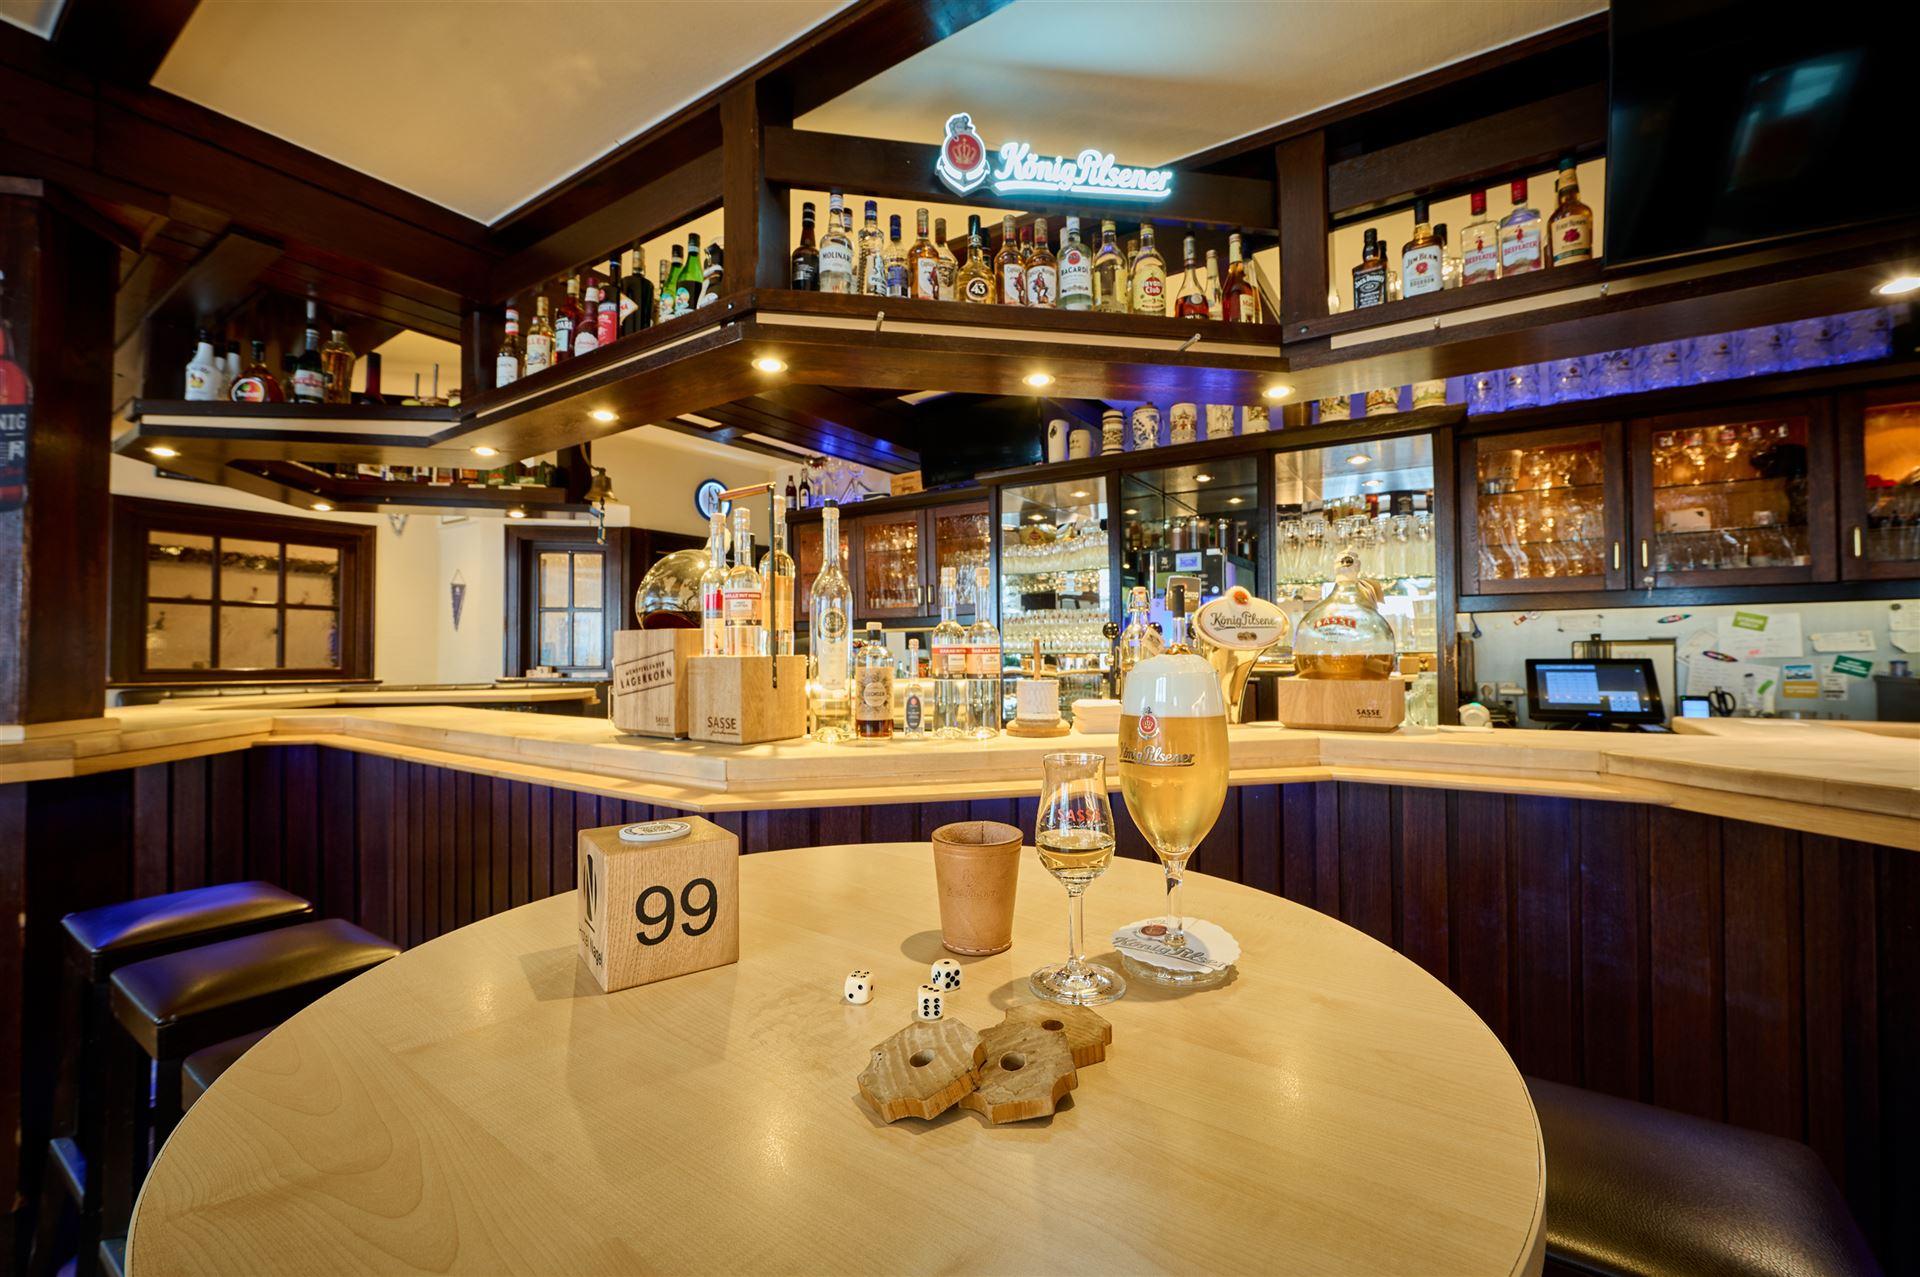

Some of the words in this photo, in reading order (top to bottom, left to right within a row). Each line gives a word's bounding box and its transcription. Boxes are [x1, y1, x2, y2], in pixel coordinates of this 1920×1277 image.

[970, 283, 986, 294] 43
[620, 668, 672, 689] LAGERKORN
[707, 716, 737, 730] SASSE
[635, 877, 718, 947] 99
